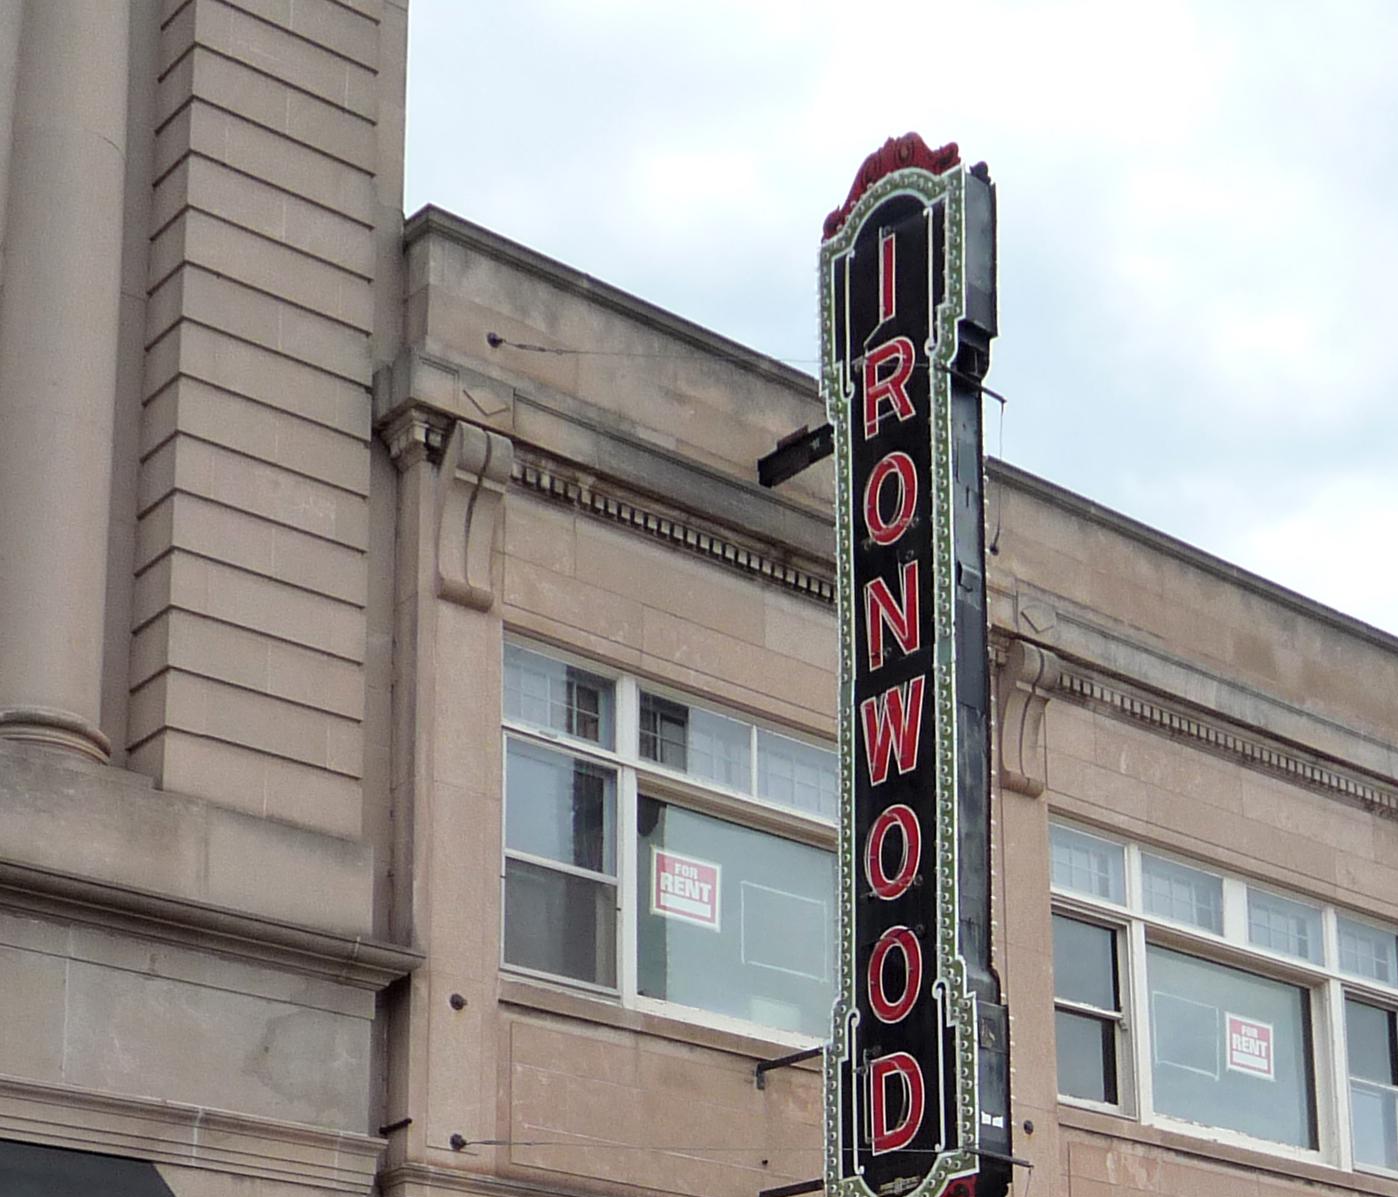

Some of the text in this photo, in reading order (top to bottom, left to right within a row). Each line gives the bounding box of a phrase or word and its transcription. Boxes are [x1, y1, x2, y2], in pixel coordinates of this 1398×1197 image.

[860, 232, 926, 1156] IRONWOOD
[674, 863, 699, 880] FOR
[660, 871, 712, 903] RENT
[1232, 1033, 1268, 1058] RENT
